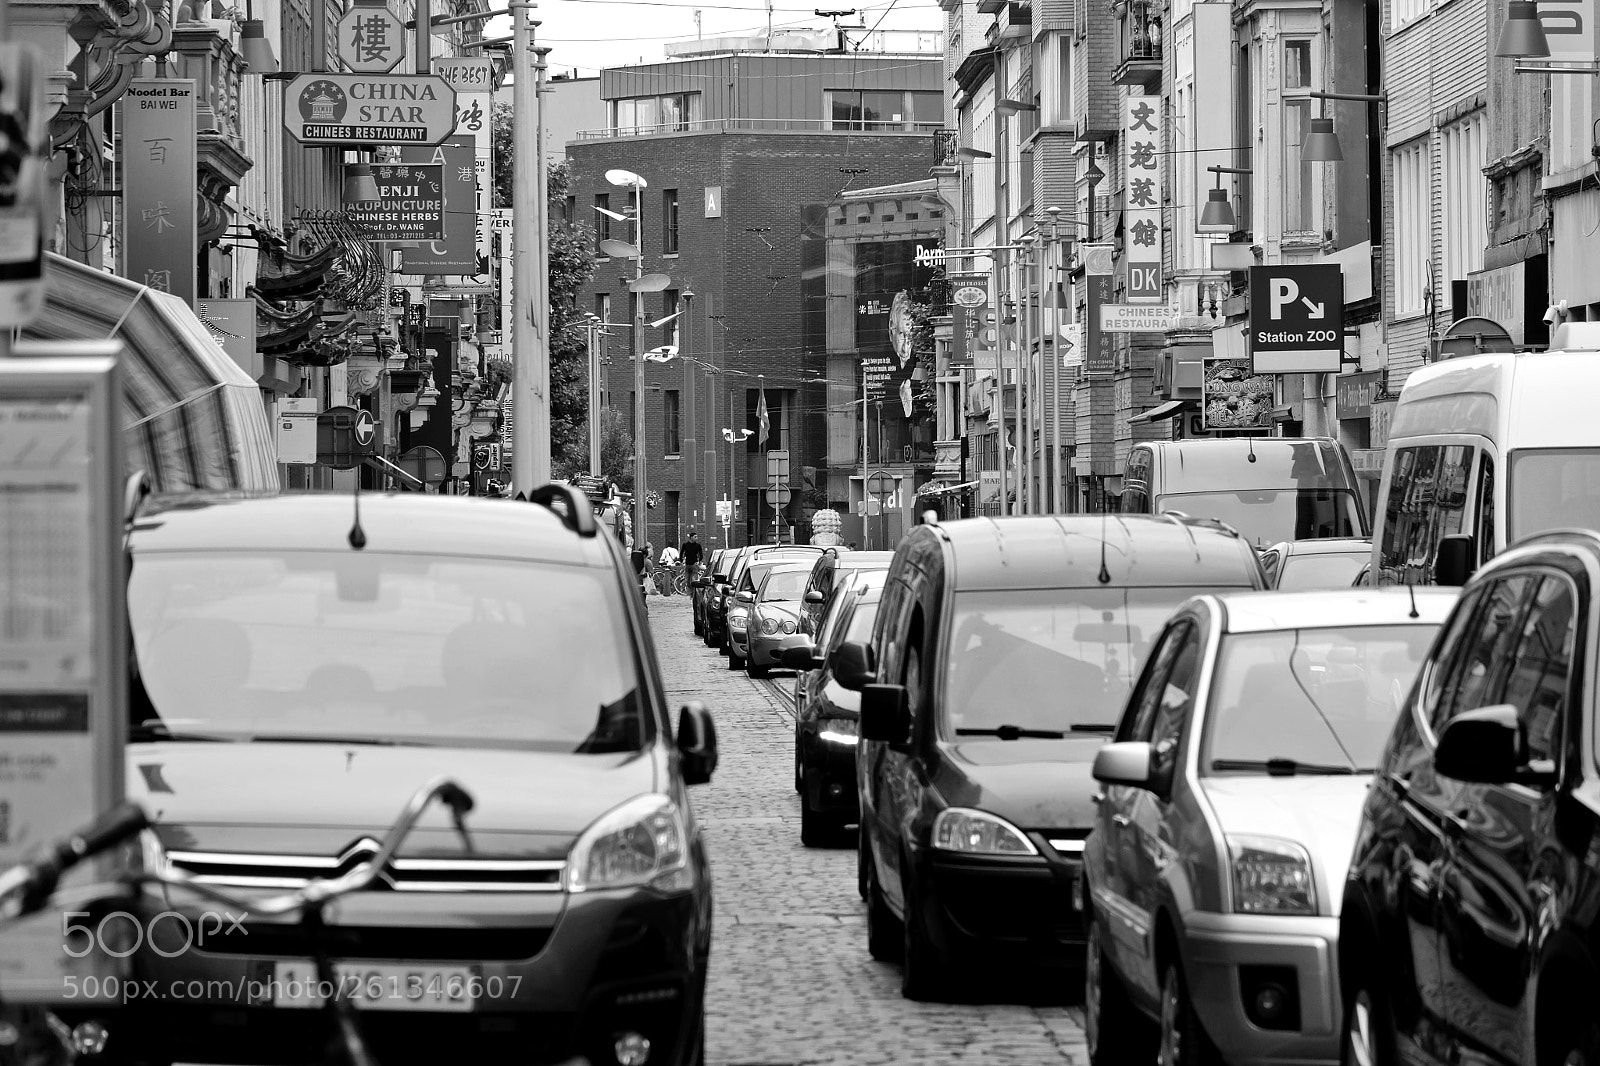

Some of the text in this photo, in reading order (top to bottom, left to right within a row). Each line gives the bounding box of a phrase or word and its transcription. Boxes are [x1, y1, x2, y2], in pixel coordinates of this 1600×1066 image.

[351, 14, 391, 63] 樓
[439, 66, 488, 84] THE BEST
[127, 88, 190, 97] Noodel Bar
[349, 82, 438, 101] CHINA
[140, 100, 177, 109] BAI WEI
[359, 105, 426, 124] STAR
[305, 125, 424, 140] CHINEES RESTAURANT
[376, 185, 420, 197] ENJI
[346, 200, 440, 211] ACUPUNCTURE
[707, 193, 716, 211] A
[348, 212, 440, 221] CHINESE HERBS
[1131, 268, 1158, 291] DK
[1269, 277, 1300, 320] P
[1118, 308, 1170, 317] CHINEES
[1258, 330, 1337, 343] Station ZOO
[491, 444, 499, 469] Jupiler
